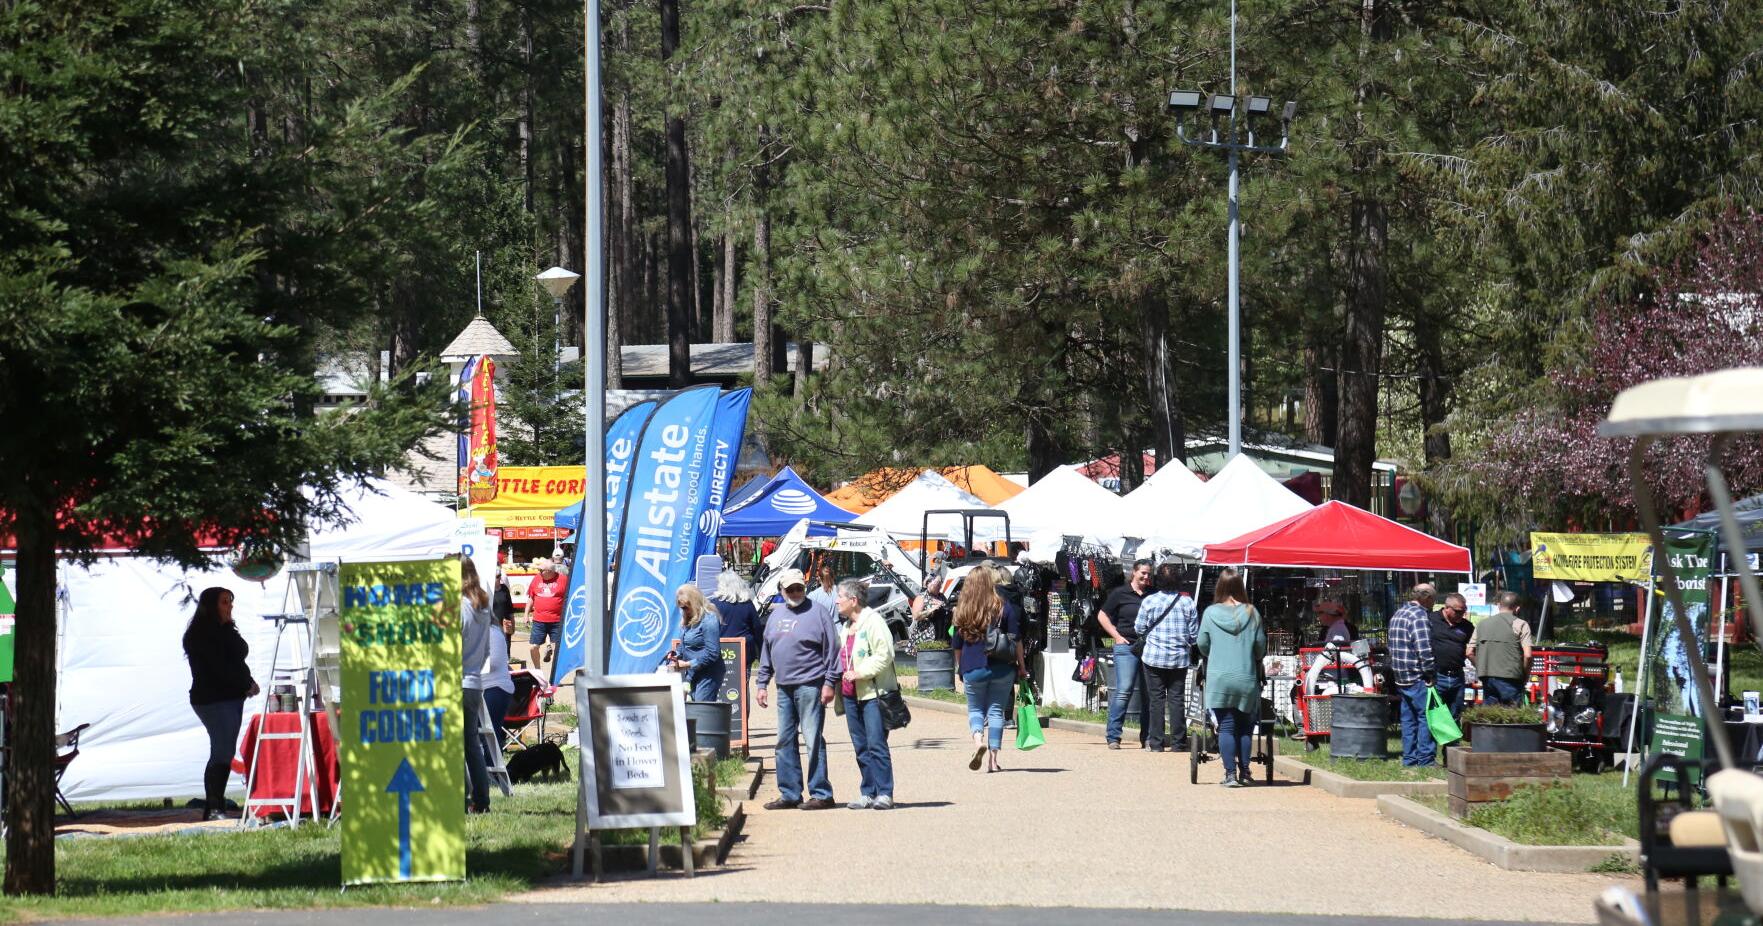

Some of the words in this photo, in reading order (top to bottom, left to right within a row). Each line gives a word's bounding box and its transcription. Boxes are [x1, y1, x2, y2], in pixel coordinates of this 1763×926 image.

[688, 424, 708, 471] hands.
[710, 439, 729, 506] DIRECTV
[687, 471, 700, 505] good
[635, 424, 689, 586] Allstate
[685, 507, 694, 519] in
[674, 522, 692, 563] You're
[1583, 555, 1615, 569] PROTECTION
[1615, 555, 1637, 570] SYSTEM
[1684, 554, 1709, 568] The
[344, 583, 445, 608] HOME
[356, 622, 445, 647] SHOW
[369, 669, 435, 705] FOOD
[359, 706, 448, 744] COURT
[618, 743, 633, 752] No
[634, 743, 653, 752] Feet
[615, 756, 625, 766] in
[627, 756, 657, 766] Flower
[627, 769, 649, 780] Beds
